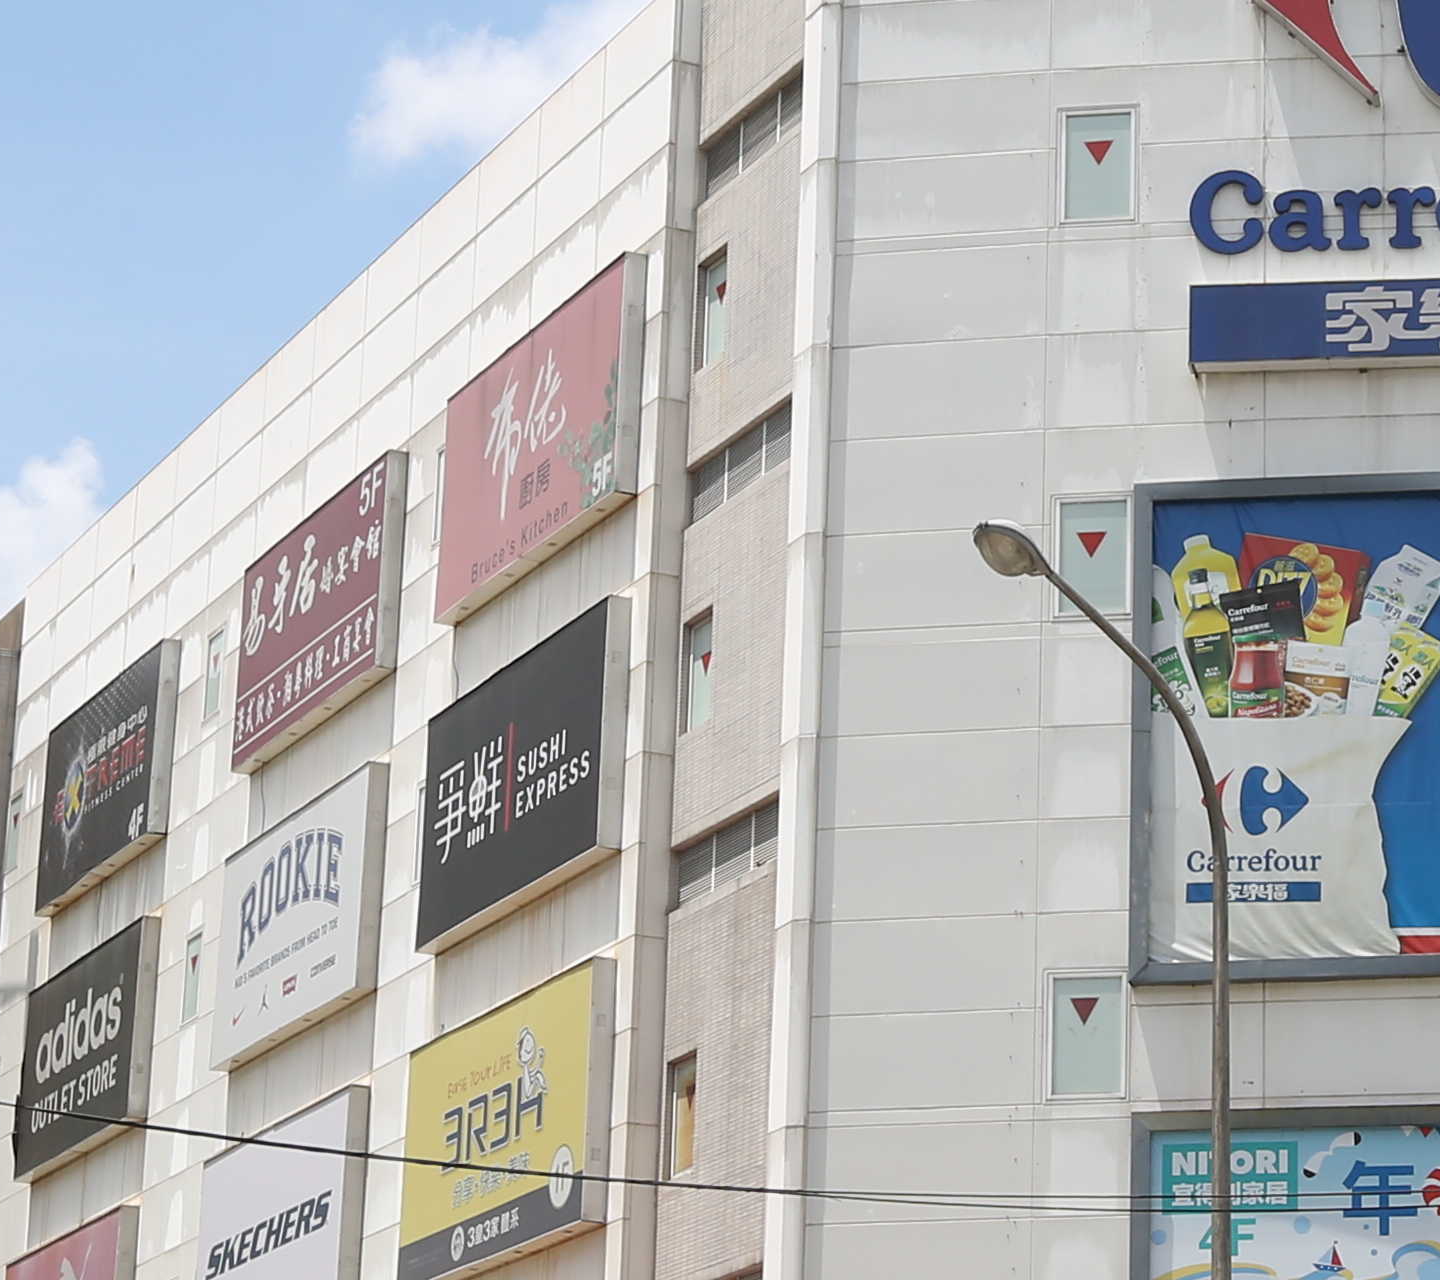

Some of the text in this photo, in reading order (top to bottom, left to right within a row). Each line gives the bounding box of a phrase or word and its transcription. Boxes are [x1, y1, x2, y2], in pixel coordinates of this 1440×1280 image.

[358, 461, 385, 517] 5F
[518, 459, 551, 510] 廚房
[591, 451, 615, 498] 5F
[471, 500, 569, 585] Bruce's Kitchen
[514, 750, 591, 819] EXPRESS
[516, 728, 568, 782] SUSHI
[128, 802, 144, 840] 4F
[434, 735, 504, 865] 爭鮮
[237, 828, 345, 970] ROOKIE
[35, 985, 122, 1084] adidas
[31, 1054, 118, 1134] OUTLET STORE
[1171, 1148, 1288, 1176] NIORI
